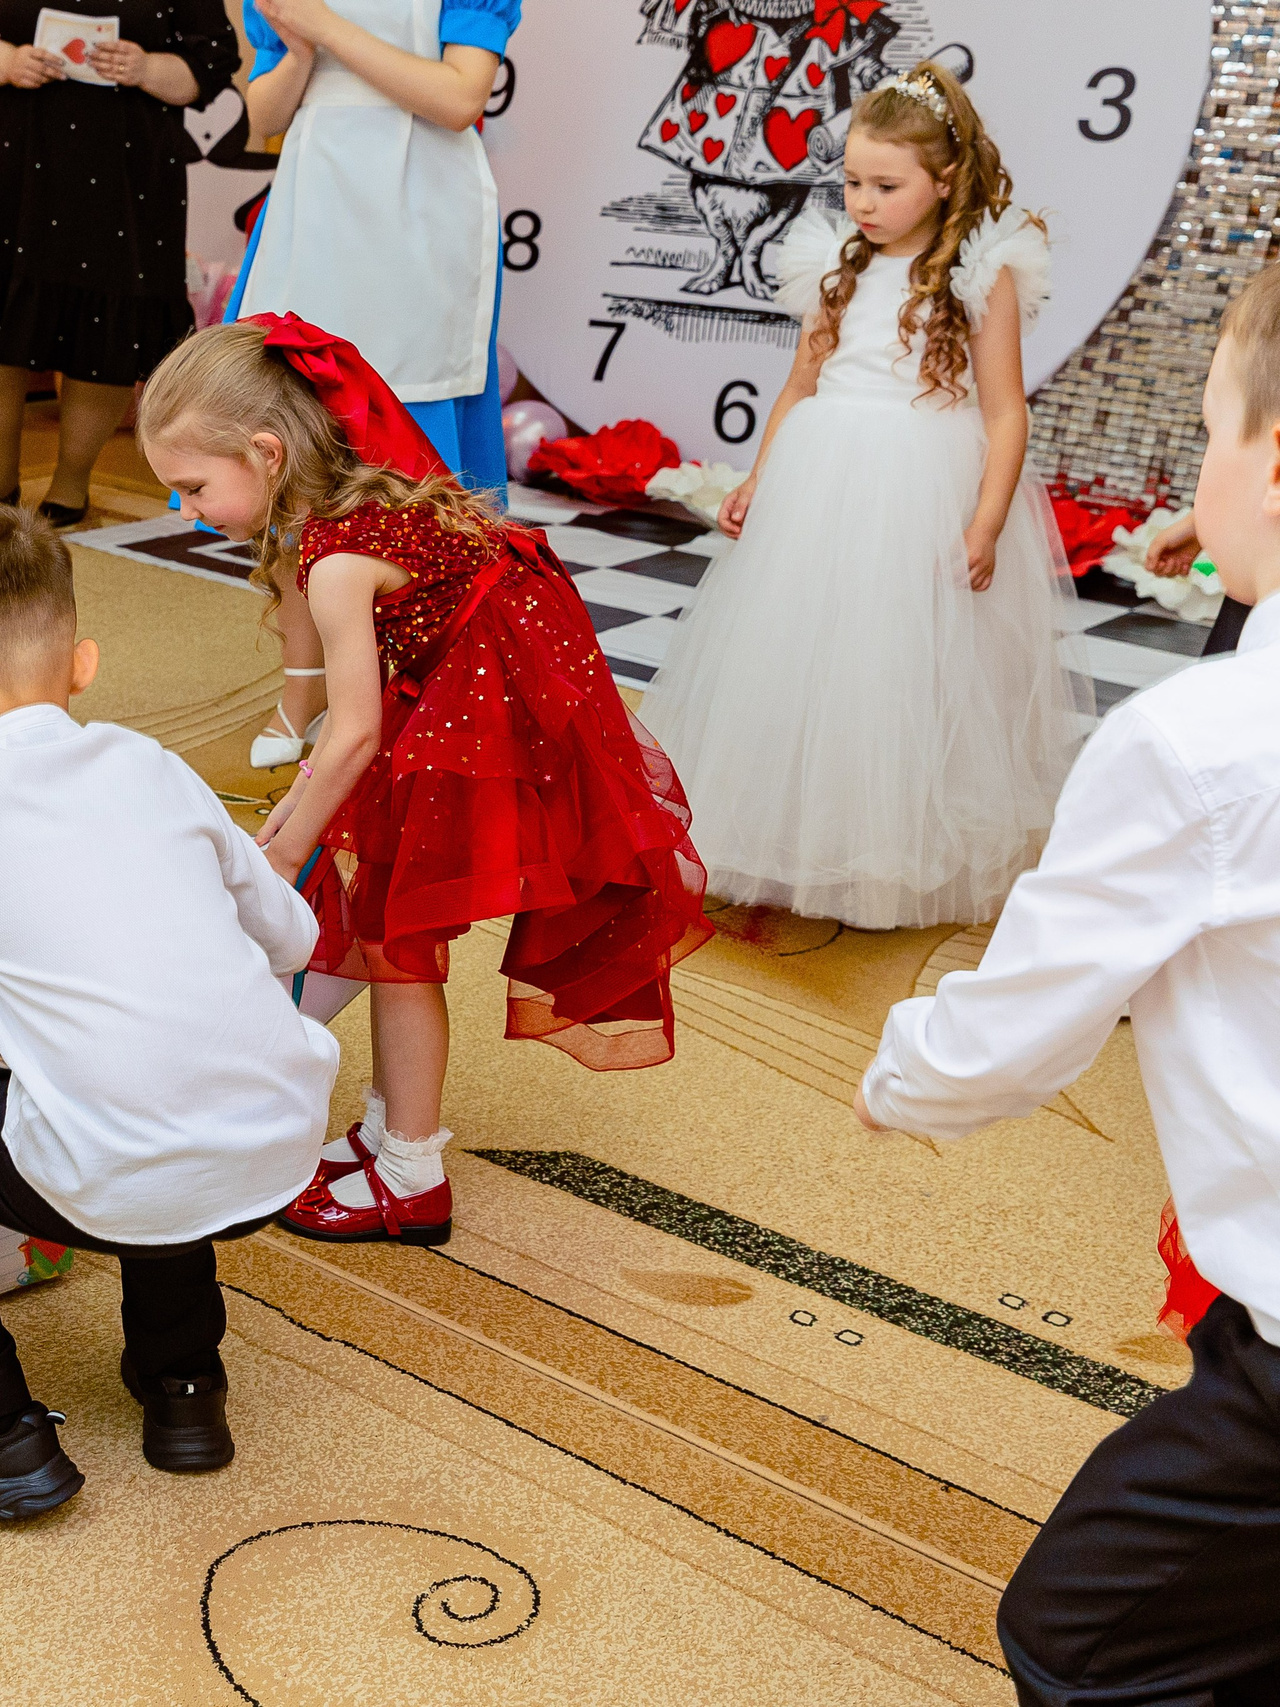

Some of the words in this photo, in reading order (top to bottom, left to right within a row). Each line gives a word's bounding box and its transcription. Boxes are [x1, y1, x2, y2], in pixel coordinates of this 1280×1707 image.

[483, 56, 516, 118] 9
[1078, 66, 1136, 142] 3
[502, 209, 542, 272] 8
[588, 319, 627, 382] 7
[713, 380, 759, 445] 6
